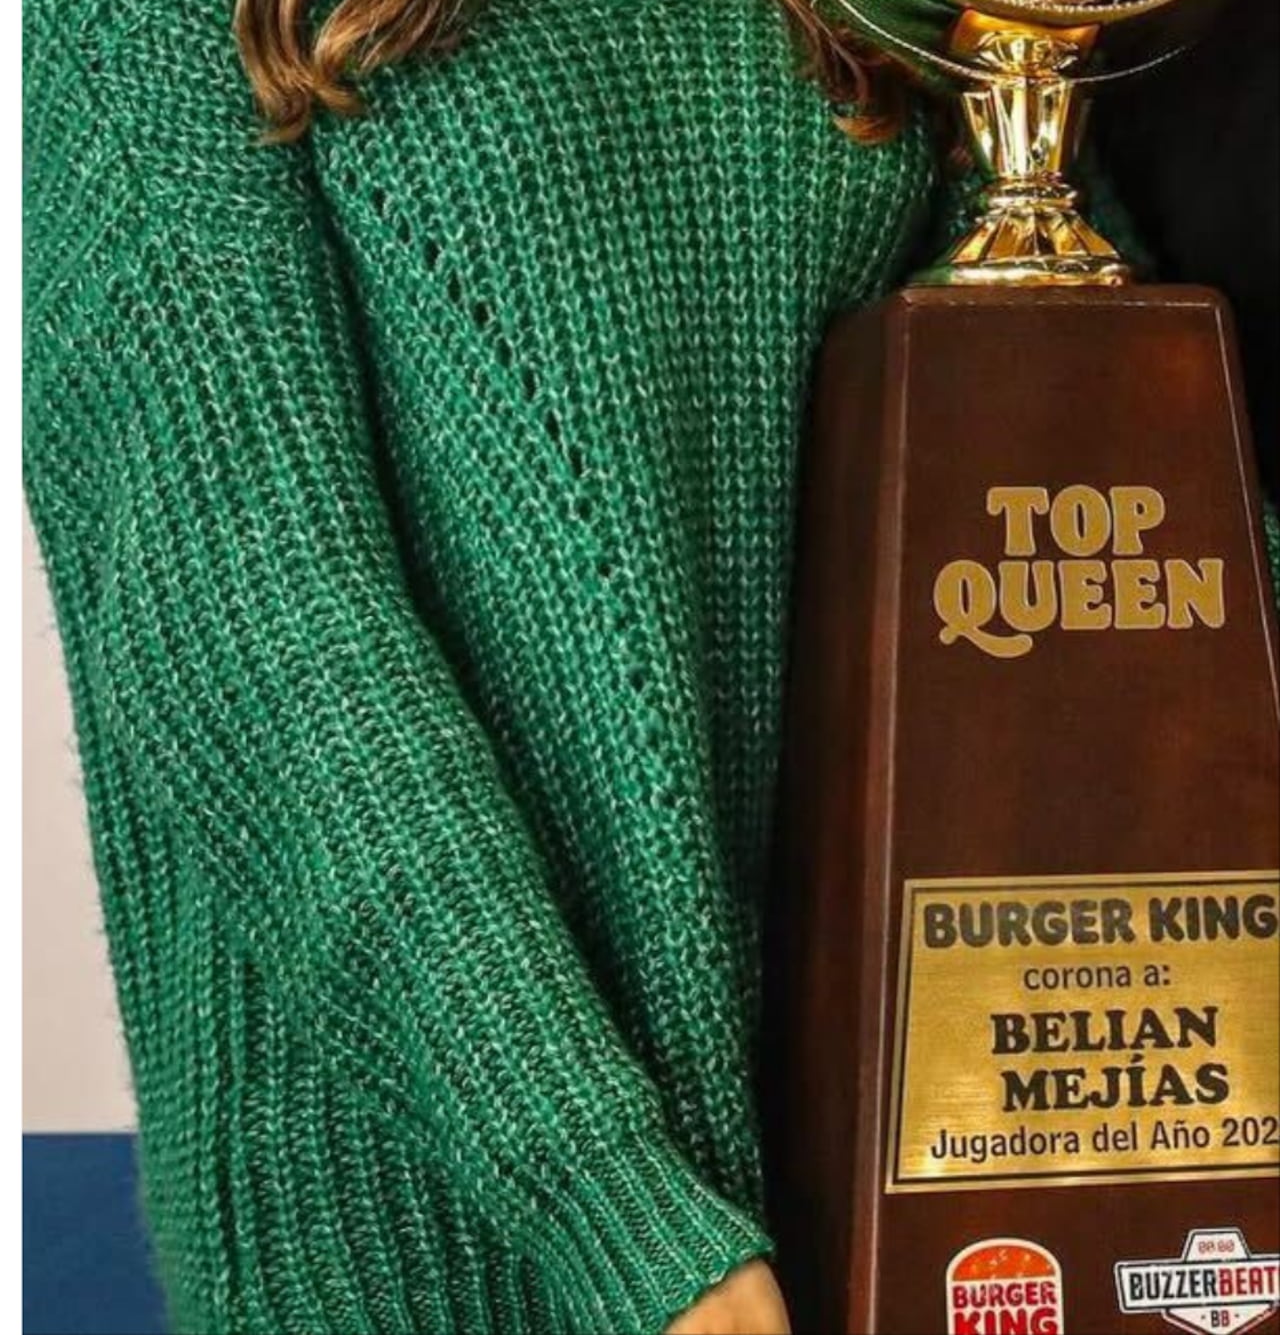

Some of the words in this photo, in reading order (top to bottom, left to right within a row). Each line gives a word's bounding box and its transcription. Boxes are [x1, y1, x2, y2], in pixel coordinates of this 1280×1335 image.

[986, 484, 1166, 557] TOP
[933, 558, 1226, 659] QUEEN
[922, 898, 1135, 949] BURGER
[1148, 893, 1279, 942] KING
[1023, 966, 1132, 991] corona
[1144, 964, 1171, 986] a:
[990, 1006, 1219, 1055] BELIAN
[1001, 1054, 1230, 1113] MEJÍAS
[931, 1126, 1081, 1164] Jugadora
[1092, 1122, 1138, 1152] del
[1150, 1120, 1211, 1150] Año
[952, 1280, 1057, 1310] BURGER
[953, 1307, 1059, 1335] KING
